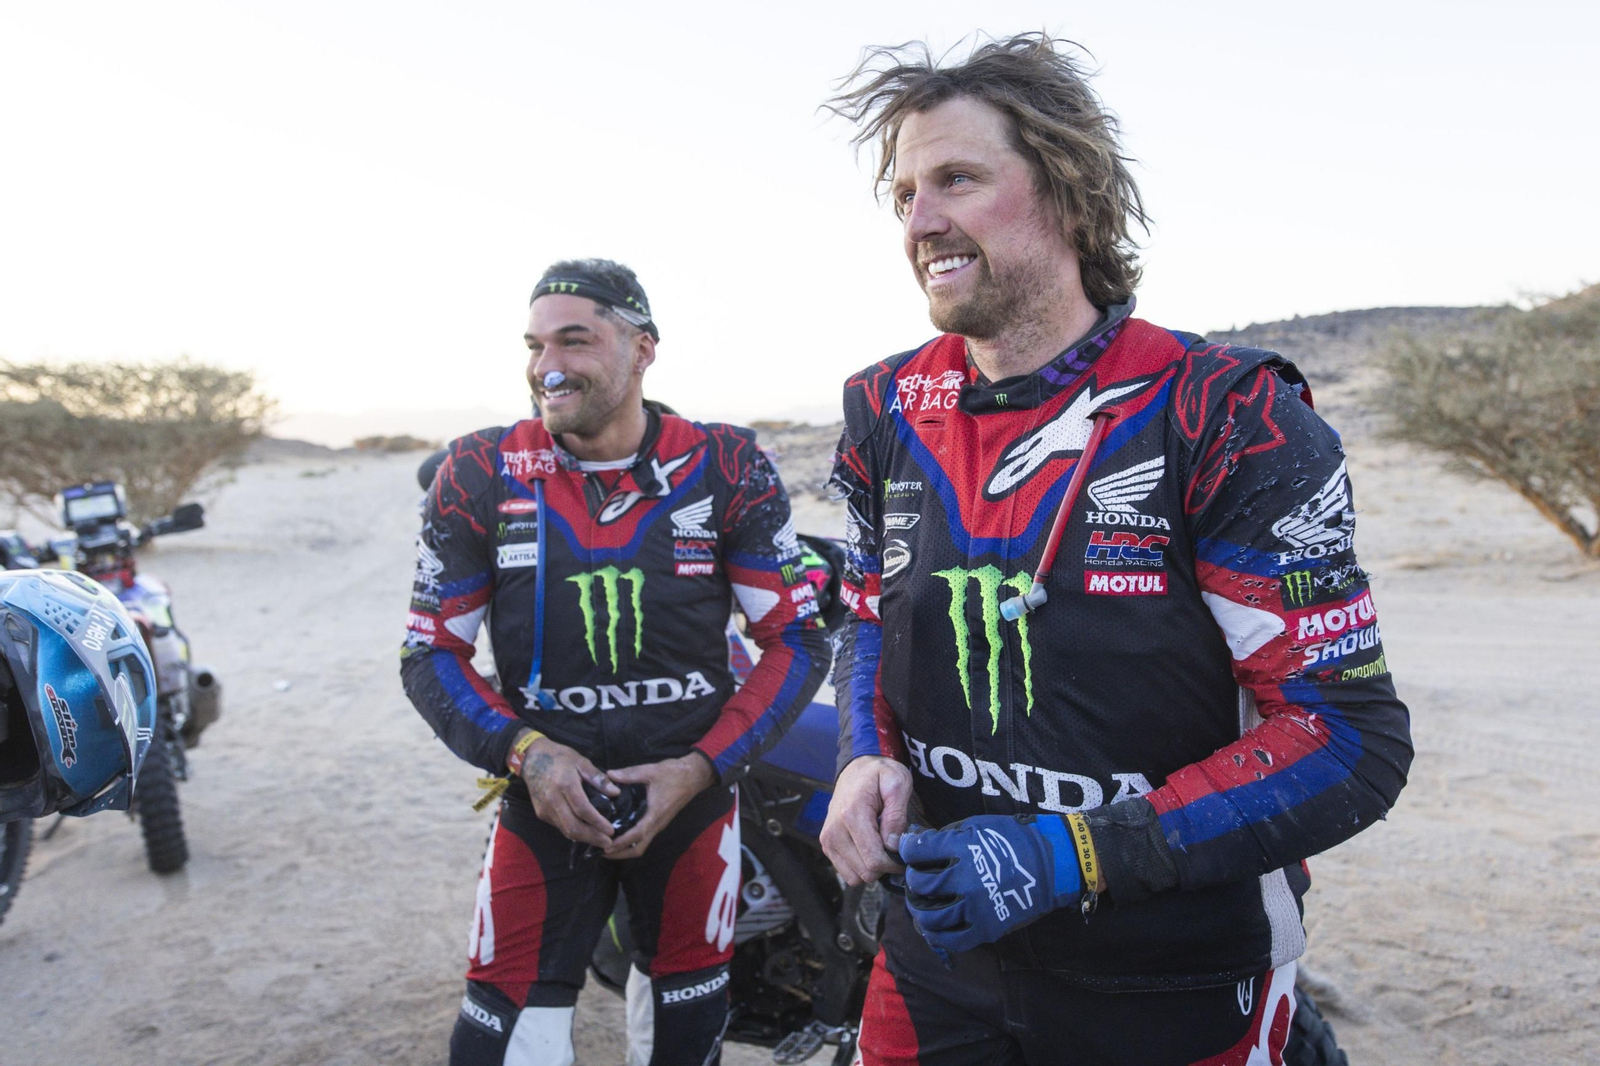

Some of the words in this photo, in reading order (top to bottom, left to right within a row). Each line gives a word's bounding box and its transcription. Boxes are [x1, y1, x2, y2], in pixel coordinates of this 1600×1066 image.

[1085, 511, 1171, 531] HONDA
[671, 529, 718, 539] HONDA
[1084, 531, 1170, 560] HRC
[1088, 575, 1164, 593] MOTUL
[518, 670, 716, 714] HONDA
[901, 730, 1156, 814] HONDA
[1077, 823, 1085, 833] 40
[1080, 834, 1089, 846] 91
[1082, 847, 1091, 860] 30
[1085, 861, 1092, 873] 60
[968, 844, 1010, 922] ASTARS
[661, 971, 731, 1005] HONDA
